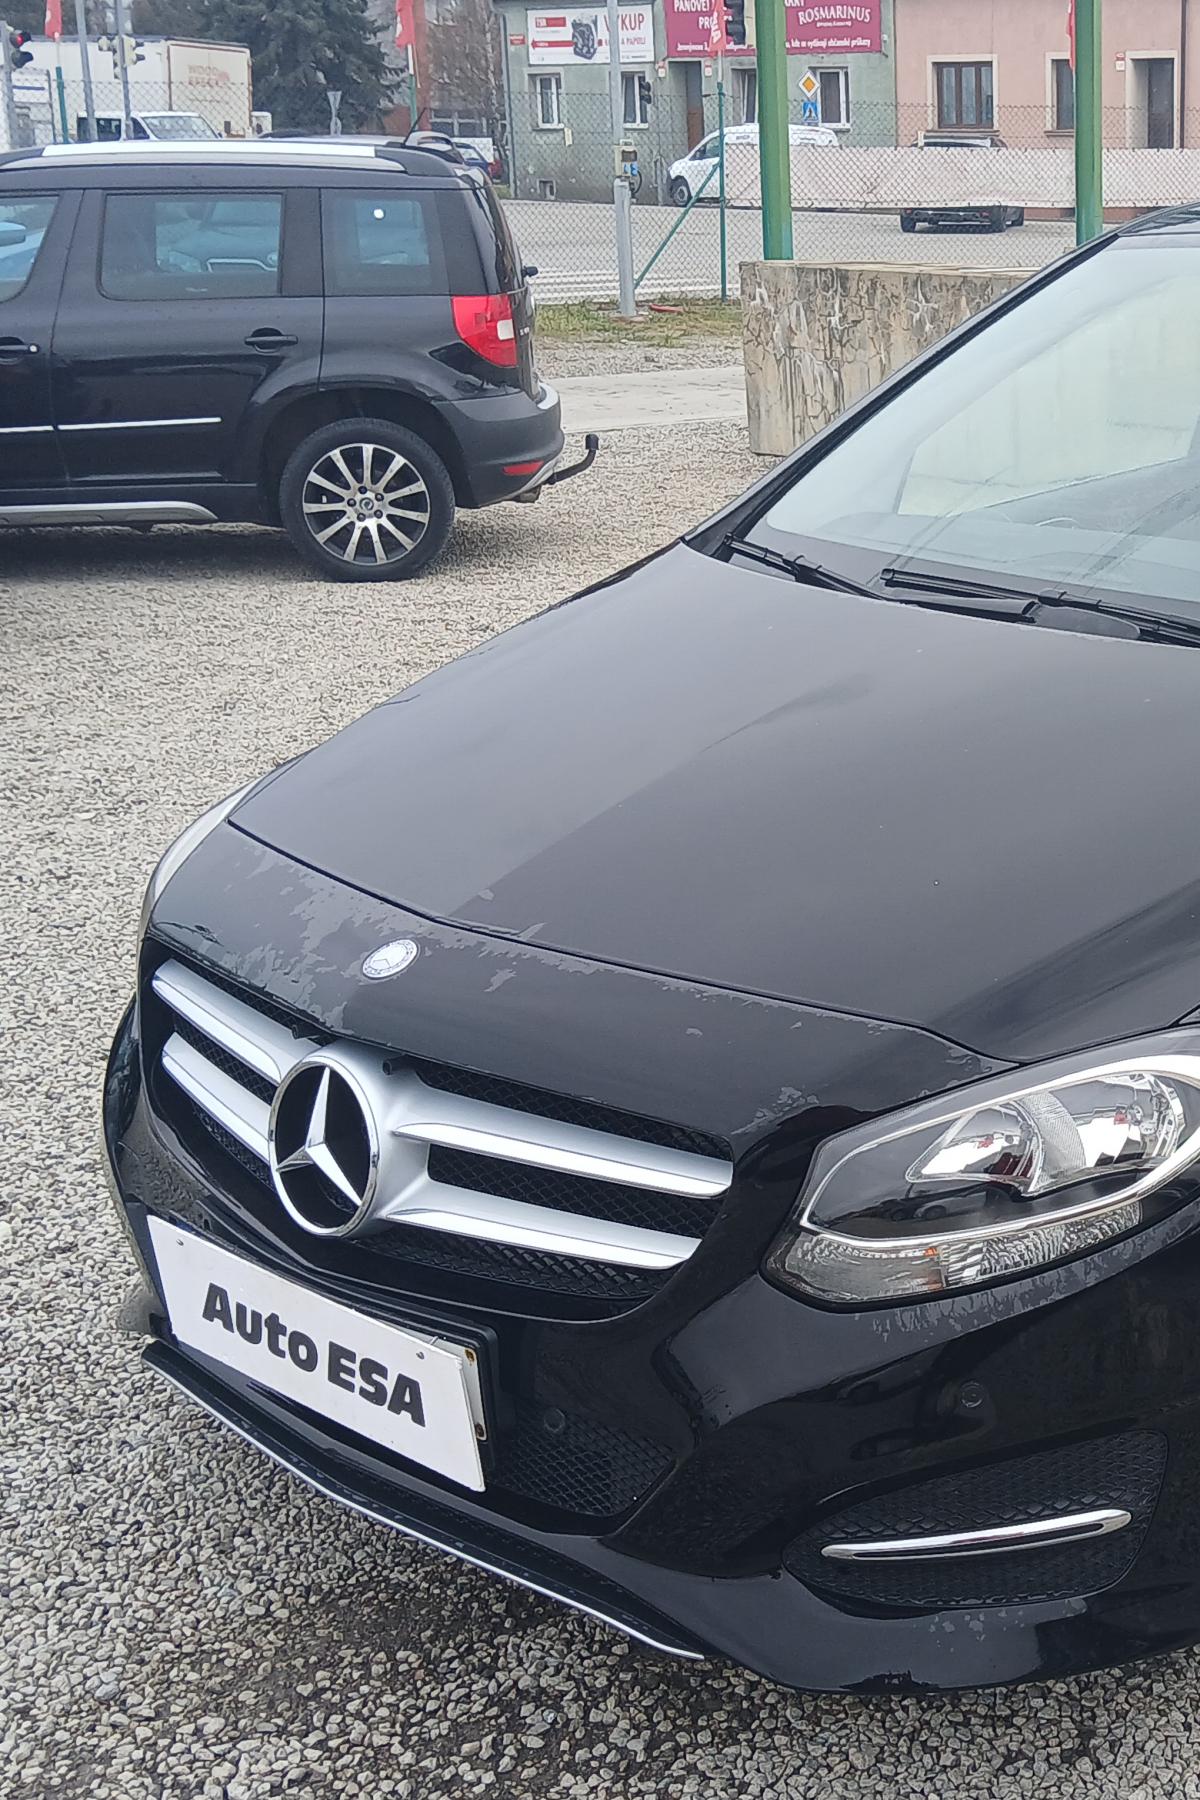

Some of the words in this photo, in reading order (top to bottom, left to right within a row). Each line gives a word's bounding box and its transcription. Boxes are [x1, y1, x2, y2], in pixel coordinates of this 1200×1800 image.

[797, 5, 871, 25] ROSMARINUS
[202, 1282, 319, 1372] Auto
[327, 1341, 426, 1428] ESA
